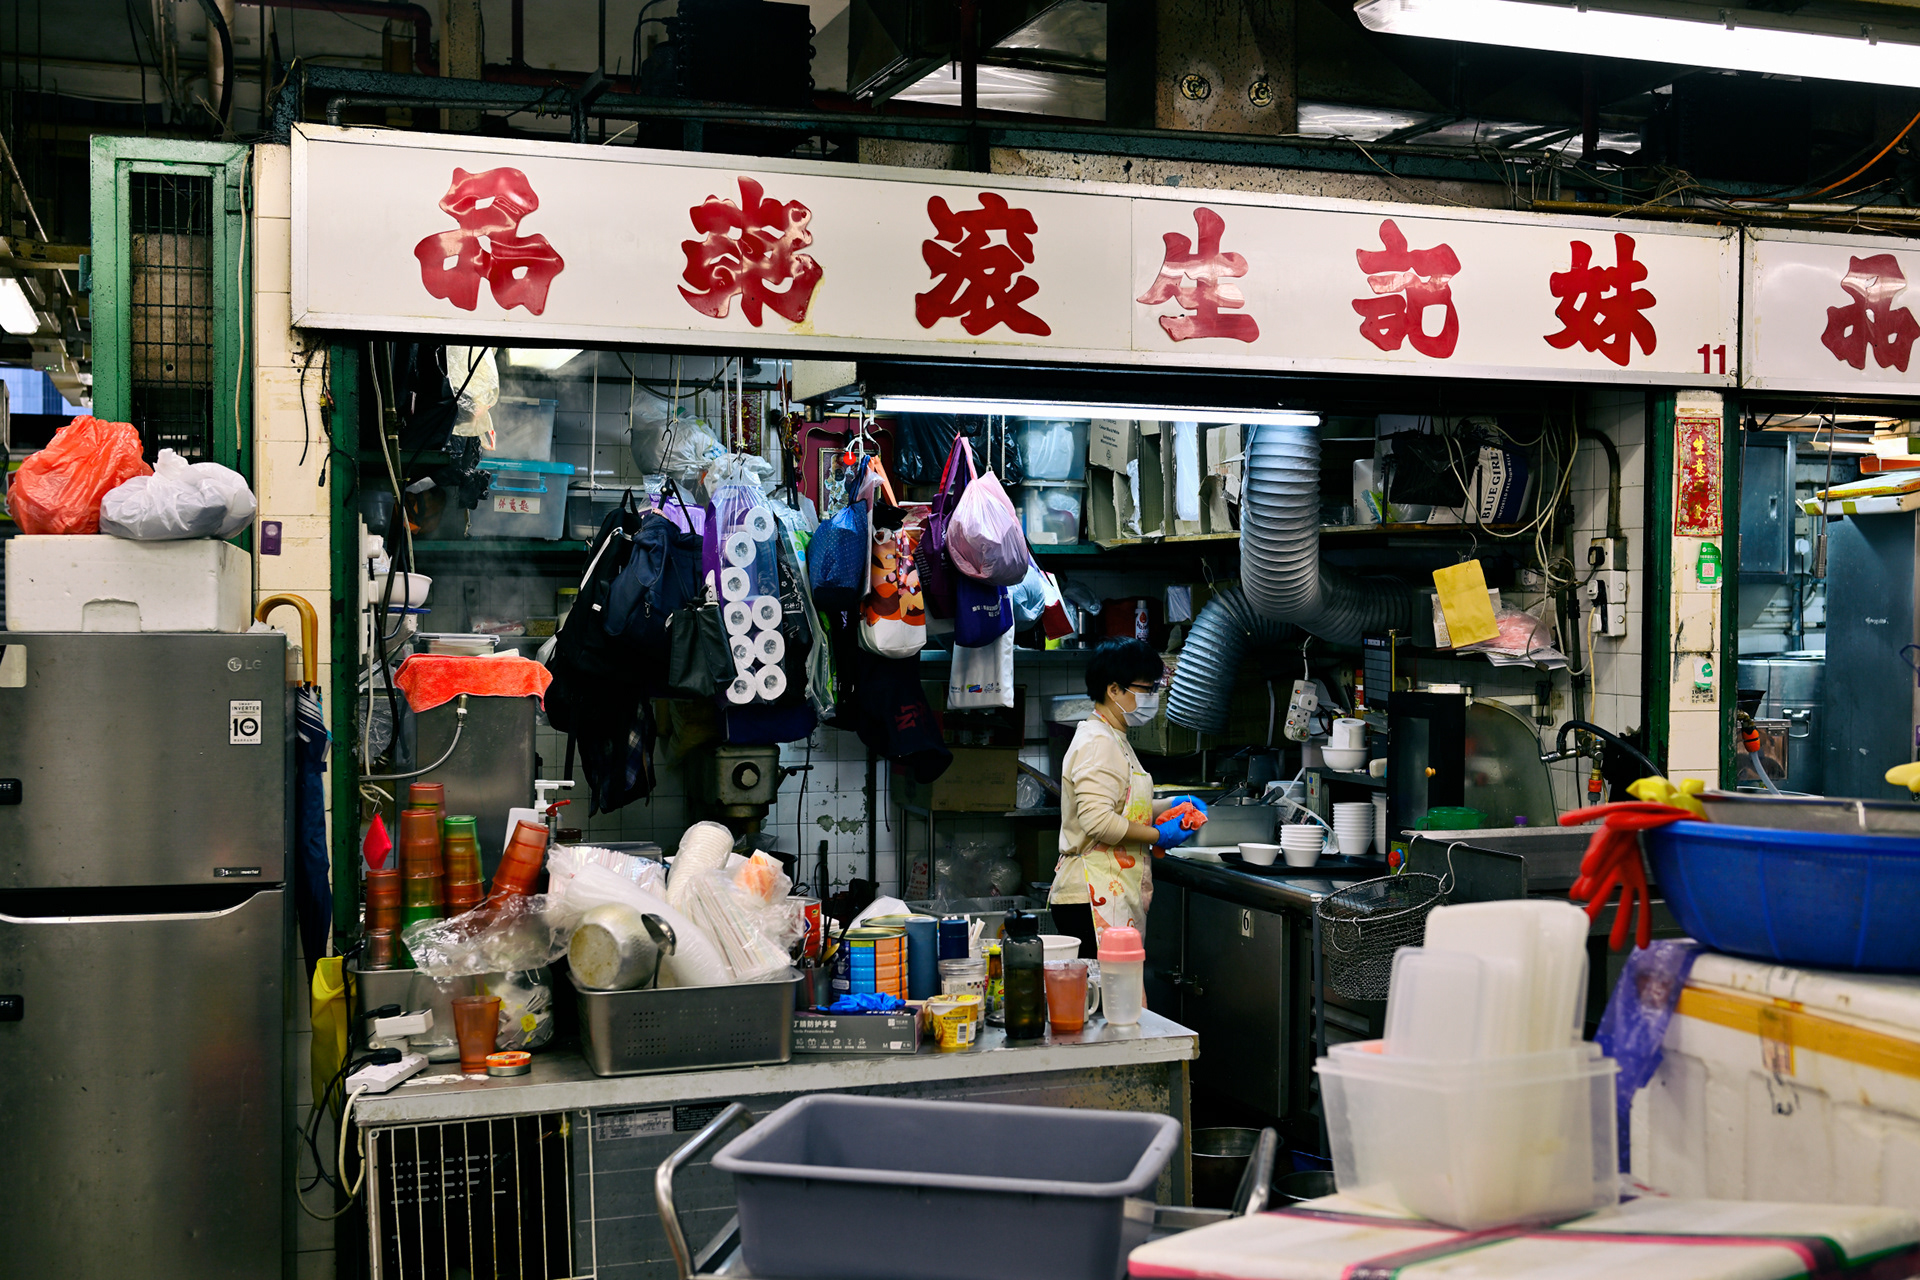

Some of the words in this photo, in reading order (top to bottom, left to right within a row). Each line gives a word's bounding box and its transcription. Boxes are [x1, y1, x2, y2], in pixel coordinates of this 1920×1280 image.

[1697, 343, 1726, 374] 11
[1481, 487, 1498, 519] BLUE
[1491, 452, 1501, 486] GIRL
[245, 659, 262, 670] LG
[233, 717, 259, 737] 10
